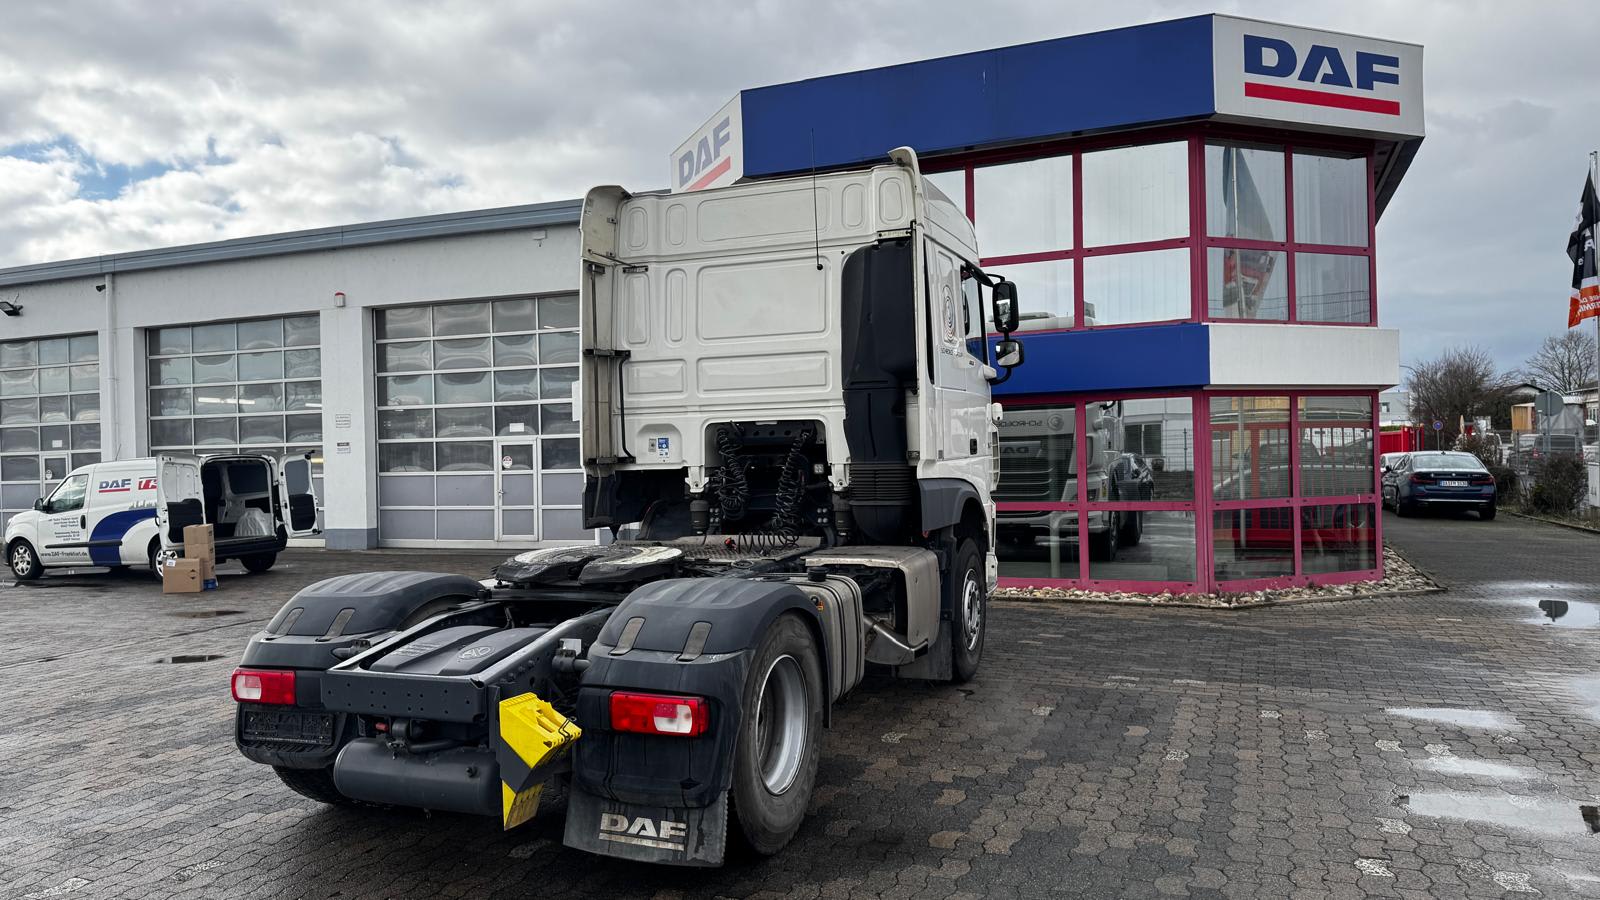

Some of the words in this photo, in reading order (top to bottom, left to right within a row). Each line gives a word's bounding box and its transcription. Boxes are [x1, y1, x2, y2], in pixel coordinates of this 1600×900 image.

[1243, 34, 1399, 91] DAF
[678, 115, 730, 188] DAF
[98, 478, 132, 489] DAF
[600, 812, 687, 839] DAF
